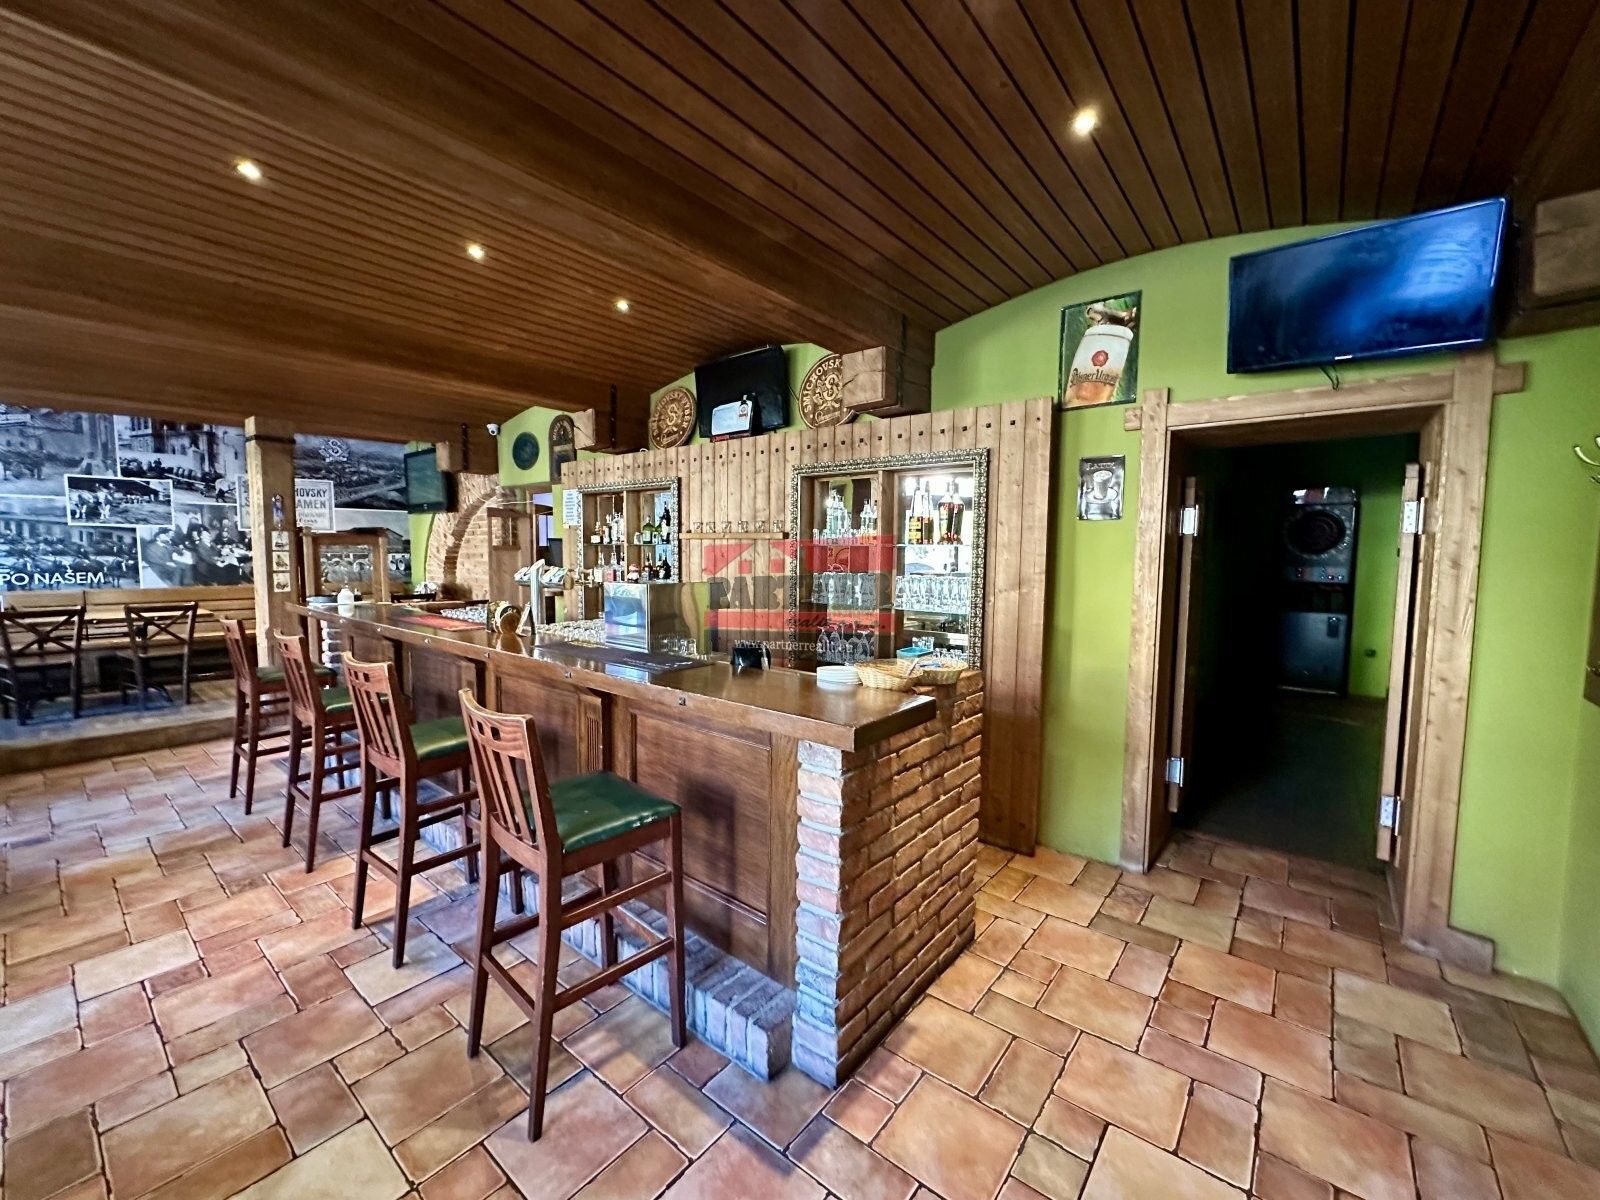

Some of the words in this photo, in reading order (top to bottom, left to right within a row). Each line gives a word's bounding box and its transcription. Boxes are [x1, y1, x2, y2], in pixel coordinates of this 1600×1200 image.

[295, 487, 328, 498] HOVSKY
[296, 499, 326, 509] AMEN
[0, 573, 29, 586] PO
[33, 564, 105, 585] NAŠEM
